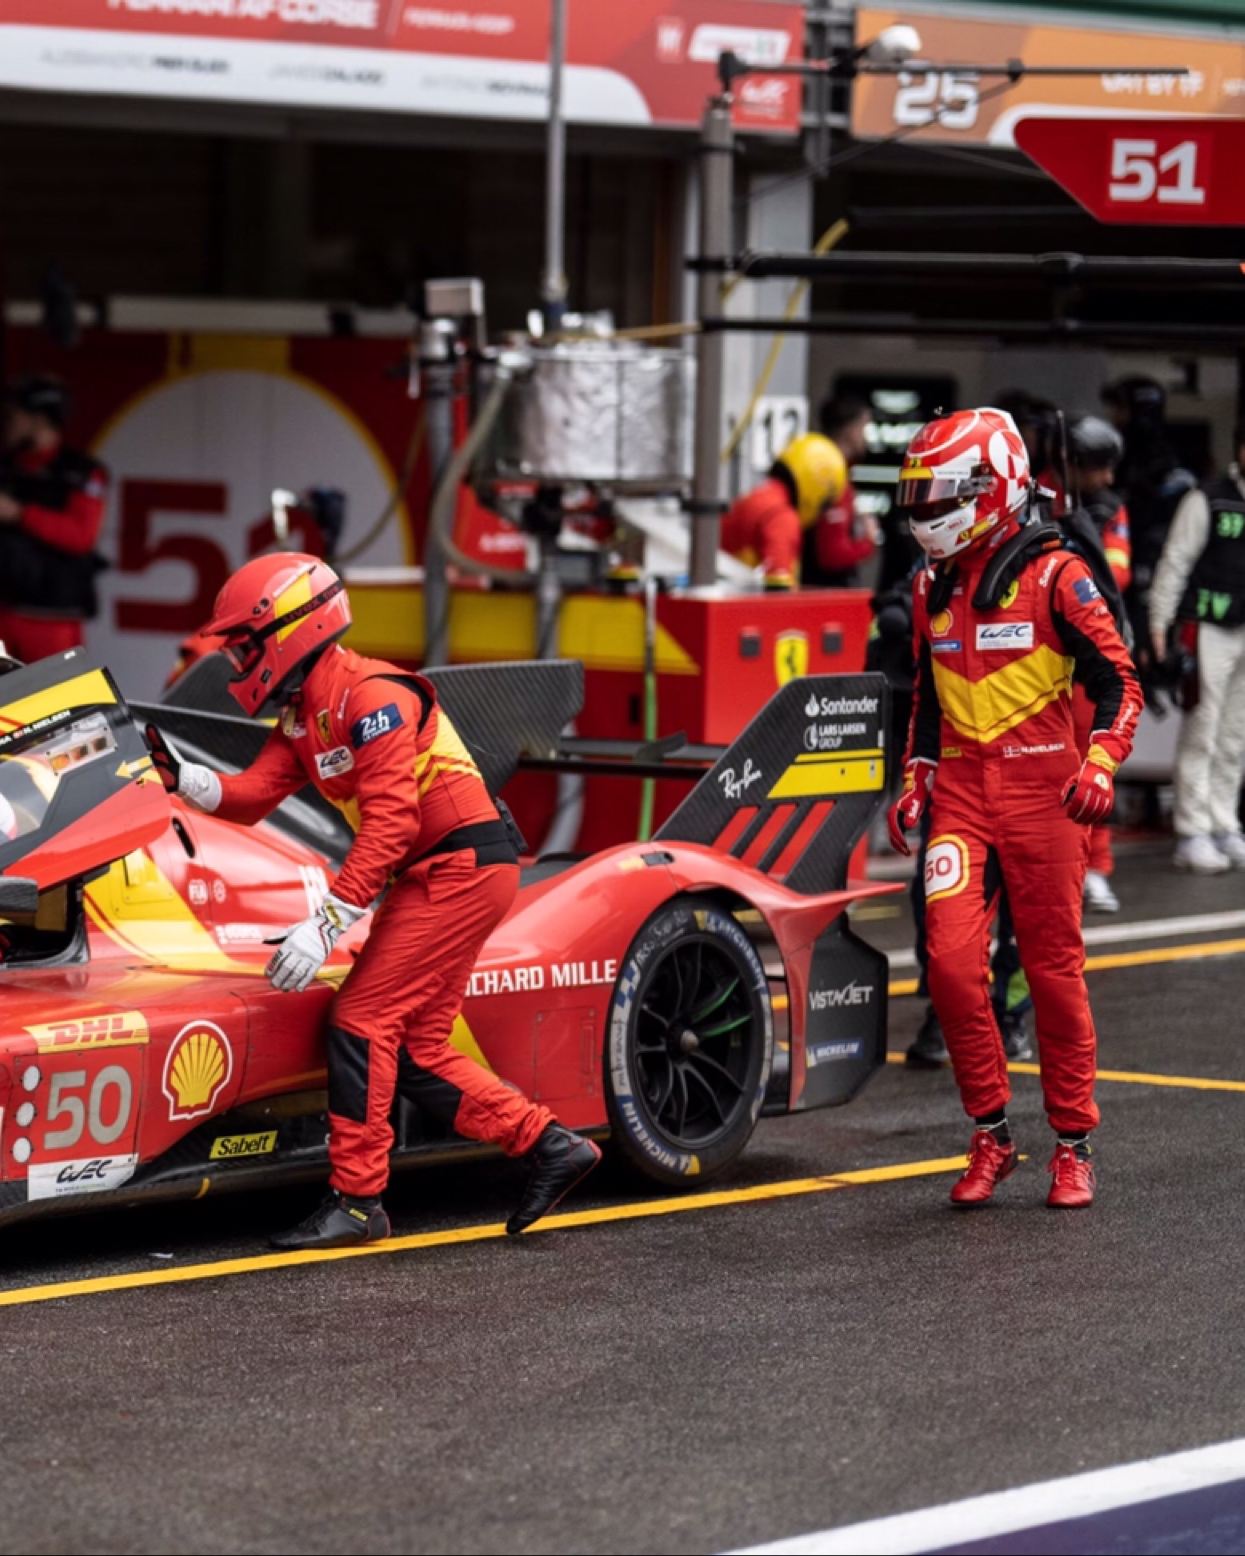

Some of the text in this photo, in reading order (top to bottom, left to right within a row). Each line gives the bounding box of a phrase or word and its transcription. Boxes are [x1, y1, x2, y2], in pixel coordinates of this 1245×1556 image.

[893, 62, 980, 128] 25
[1109, 138, 1205, 204] 51
[980, 625, 1030, 639] WEC
[820, 696, 878, 716] Santander
[32, 710, 72, 731] NIELSEN
[818, 722, 867, 736] LARS LARSEN
[818, 737, 843, 748] GROUP
[464, 959, 617, 998] ICHARD MILLE
[48, 1017, 136, 1046] DHL
[43, 1065, 132, 1150] 50
[217, 1134, 270, 1156] Sabelt
[56, 1159, 113, 1184] WEC
